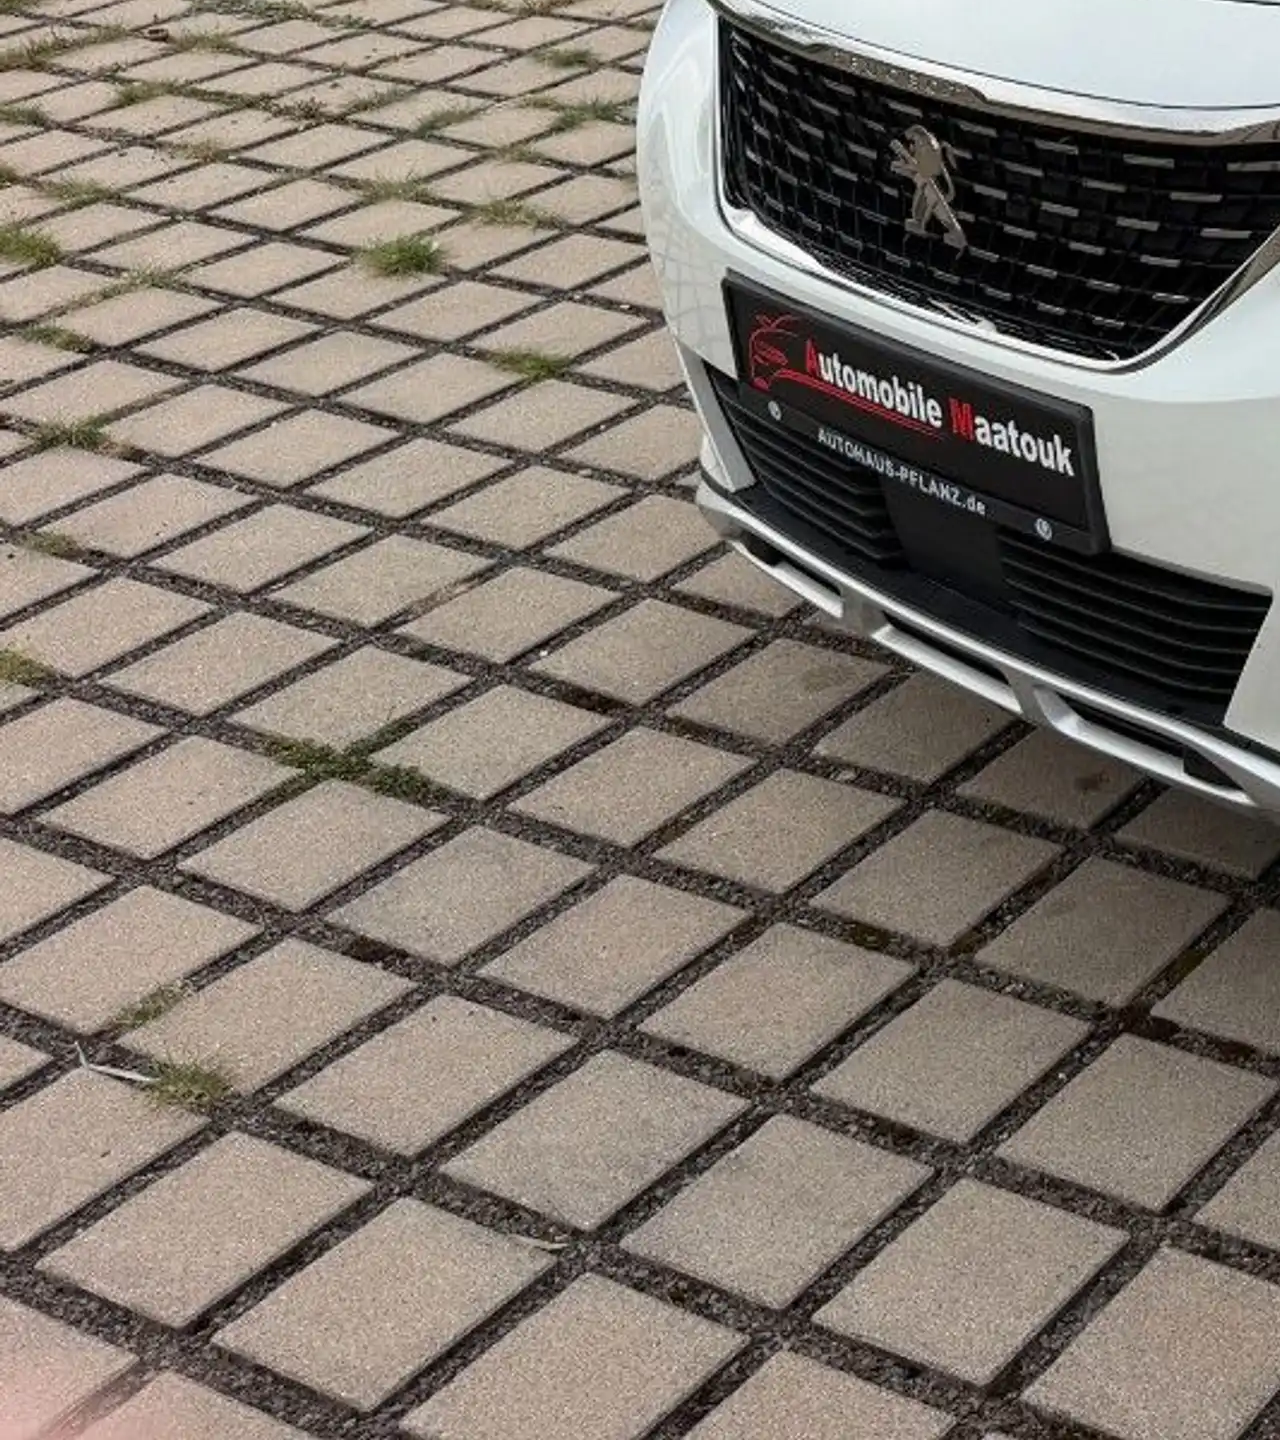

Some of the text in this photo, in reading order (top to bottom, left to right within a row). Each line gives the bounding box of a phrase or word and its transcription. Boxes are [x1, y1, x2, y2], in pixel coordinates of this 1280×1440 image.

[806, 339, 1075, 477] Automobile Maatouk
[817, 427, 987, 516] AUTOHAUS-PFLANZ.de
